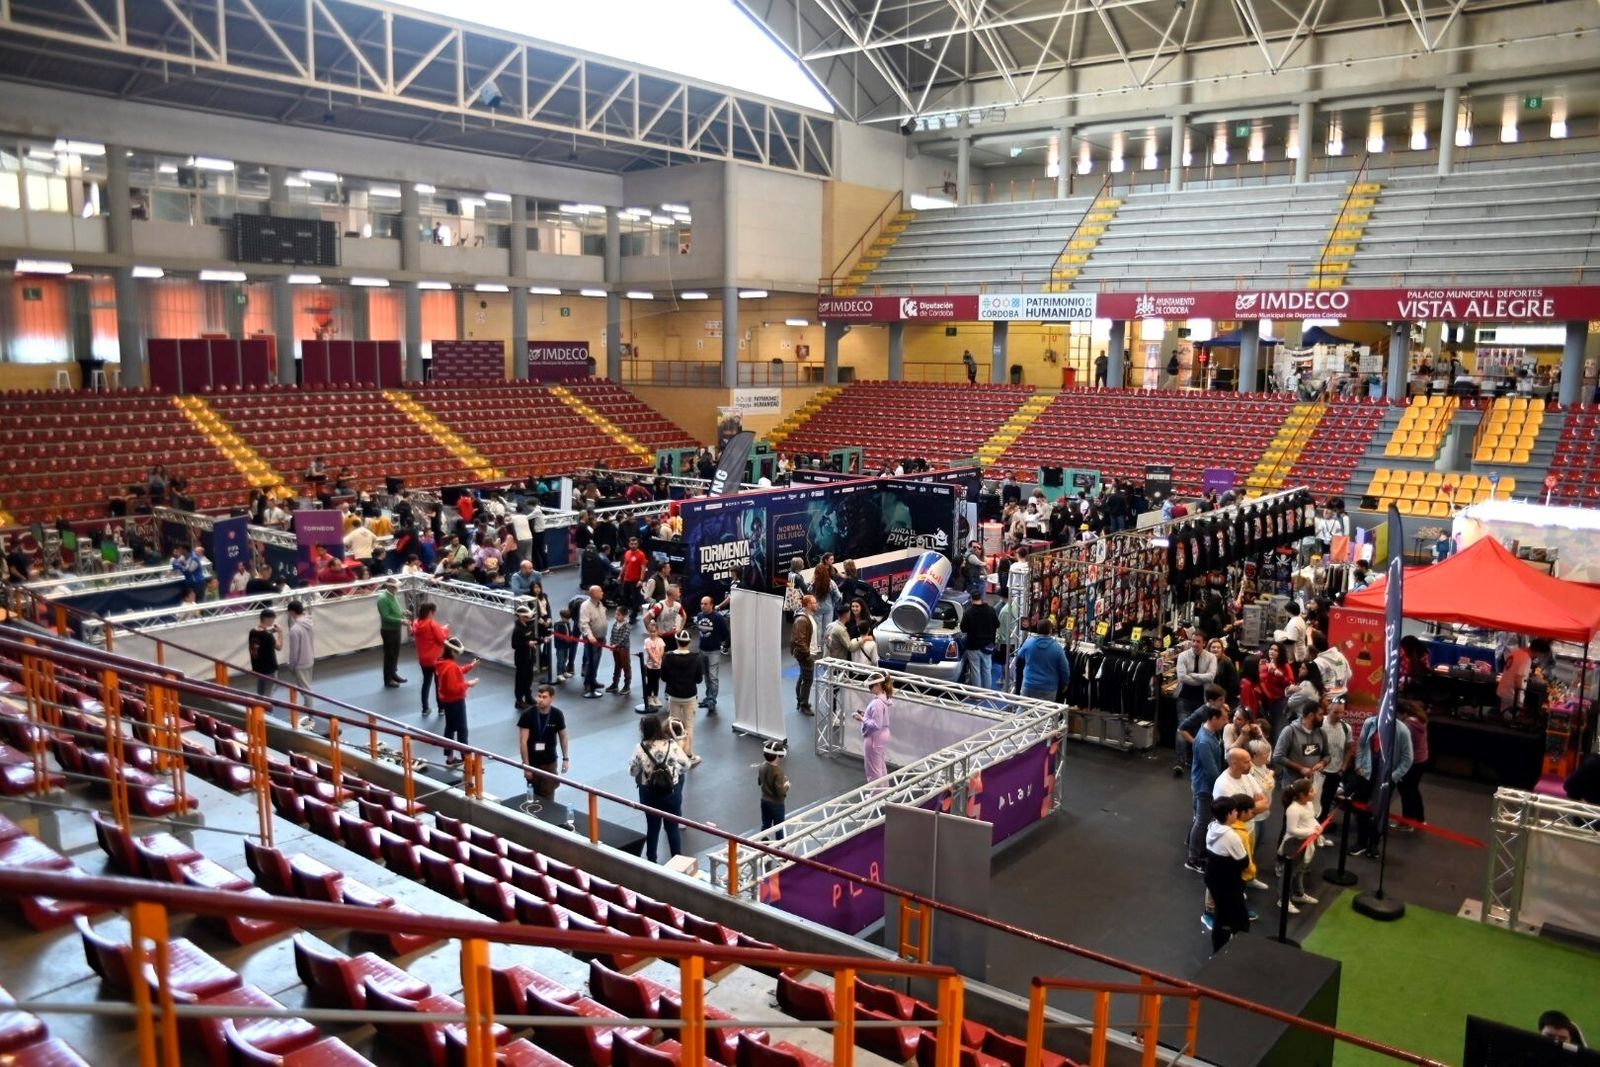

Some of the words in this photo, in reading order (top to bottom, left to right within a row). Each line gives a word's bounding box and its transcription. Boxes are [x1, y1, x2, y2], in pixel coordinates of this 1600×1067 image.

[1530, 99, 1537, 108] 8
[1407, 291, 1444, 299] PALACIO
[1446, 290, 1494, 298] MUNICIPAL
[1497, 289, 1543, 298] DEPORTES
[1026, 297, 1085, 307] PATRIMONIO
[1155, 297, 1195, 306] AYUNTAMIENTO
[1261, 292, 1349, 310] IMDECO
[830, 301, 873, 312] IMDECO
[919, 302, 954, 311] Diputación
[1397, 301, 1456, 318] VISTA
[1464, 300, 1555, 317] ALEGRE
[1025, 308, 1092, 318] HUMANIDAD
[542, 348, 589, 360] IMDECO
[778, 524, 803, 533] NORMAS
[891, 527, 910, 535] LANZA
[776, 532, 788, 541] DEL
[788, 530, 805, 539] JUEGO
[700, 540, 750, 564] TORMENTA
[701, 557, 750, 574] FANZONE
